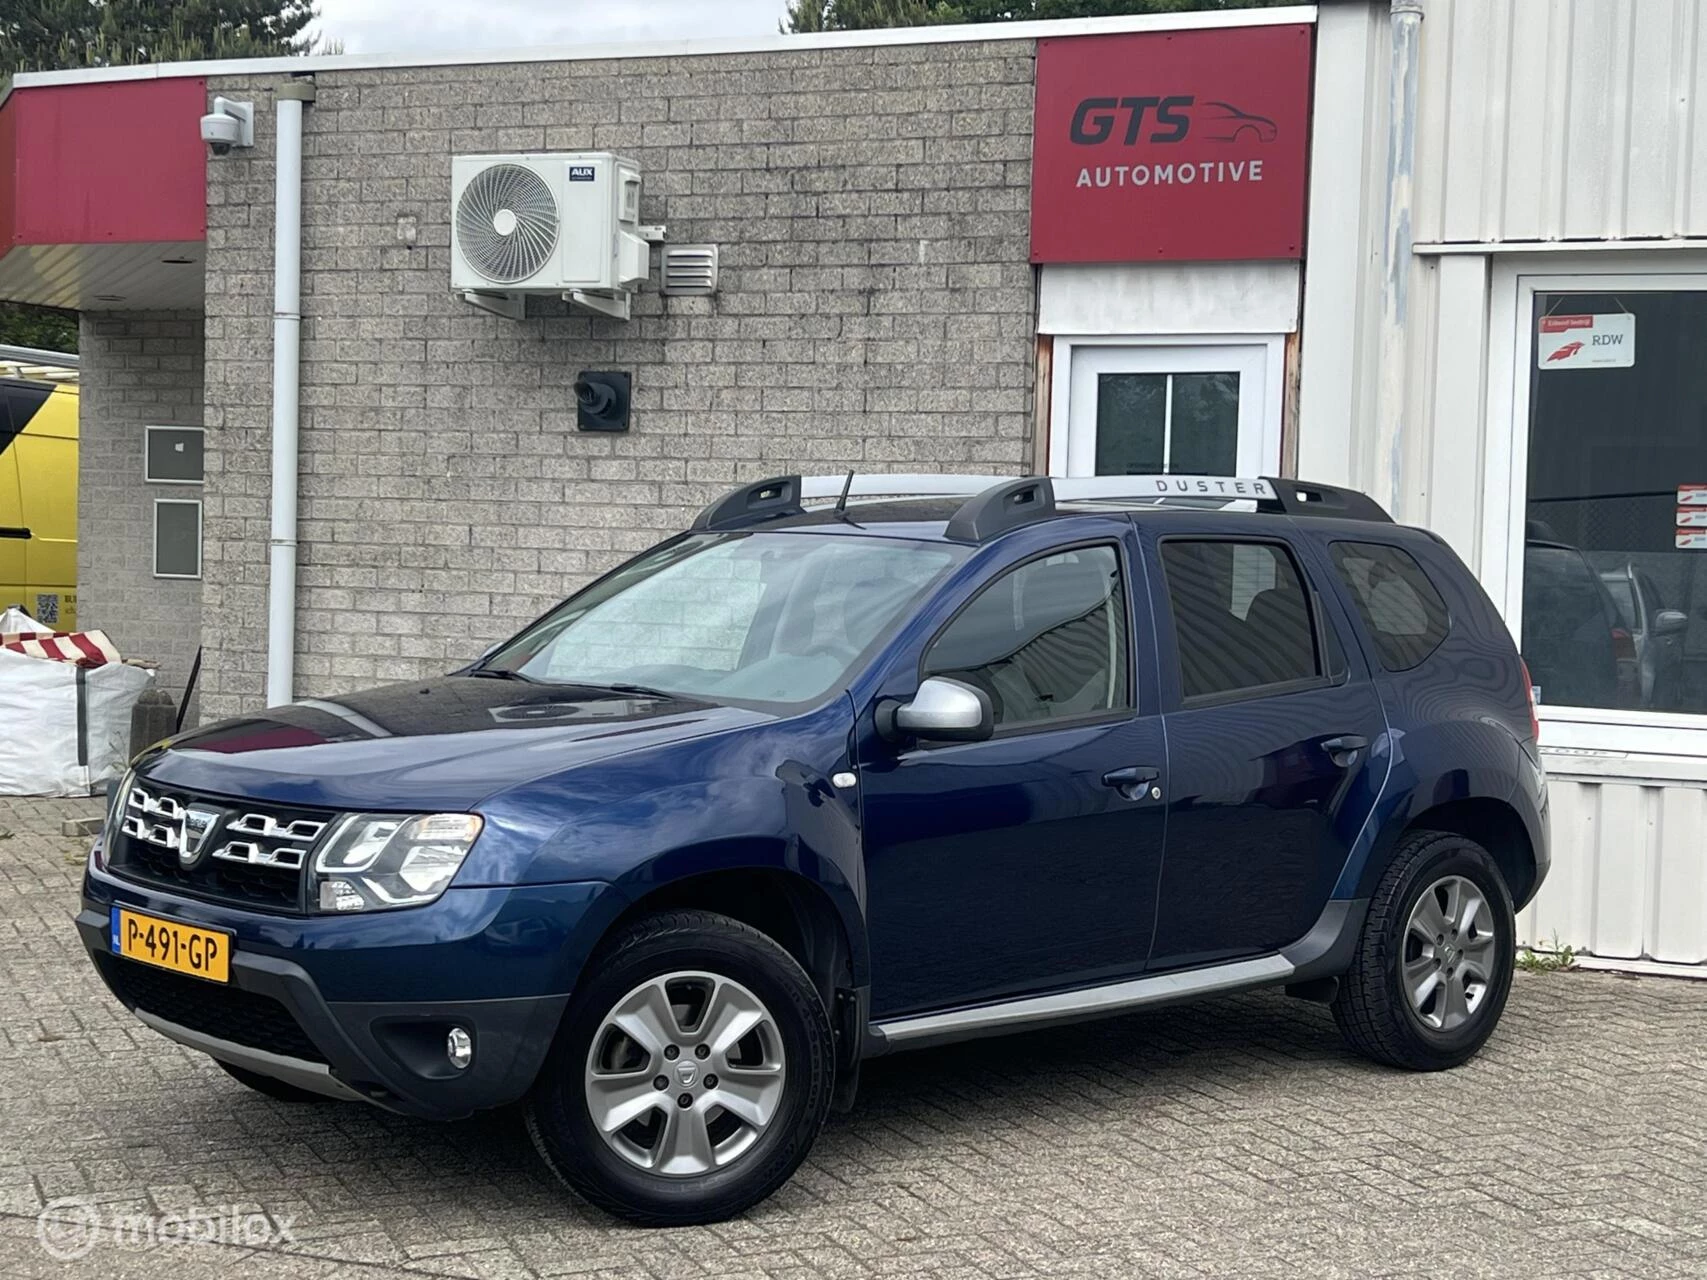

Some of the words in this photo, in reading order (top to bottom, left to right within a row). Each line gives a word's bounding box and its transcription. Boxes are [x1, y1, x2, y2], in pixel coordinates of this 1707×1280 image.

[1070, 96, 1195, 146] GTS
[571, 168, 593, 176] AUX
[1076, 160, 1264, 188] AUTOMOTIVE
[1592, 334, 1624, 346] RDW
[1156, 480, 1266, 495] DUSTER
[128, 918, 218, 972] P-491-GP
